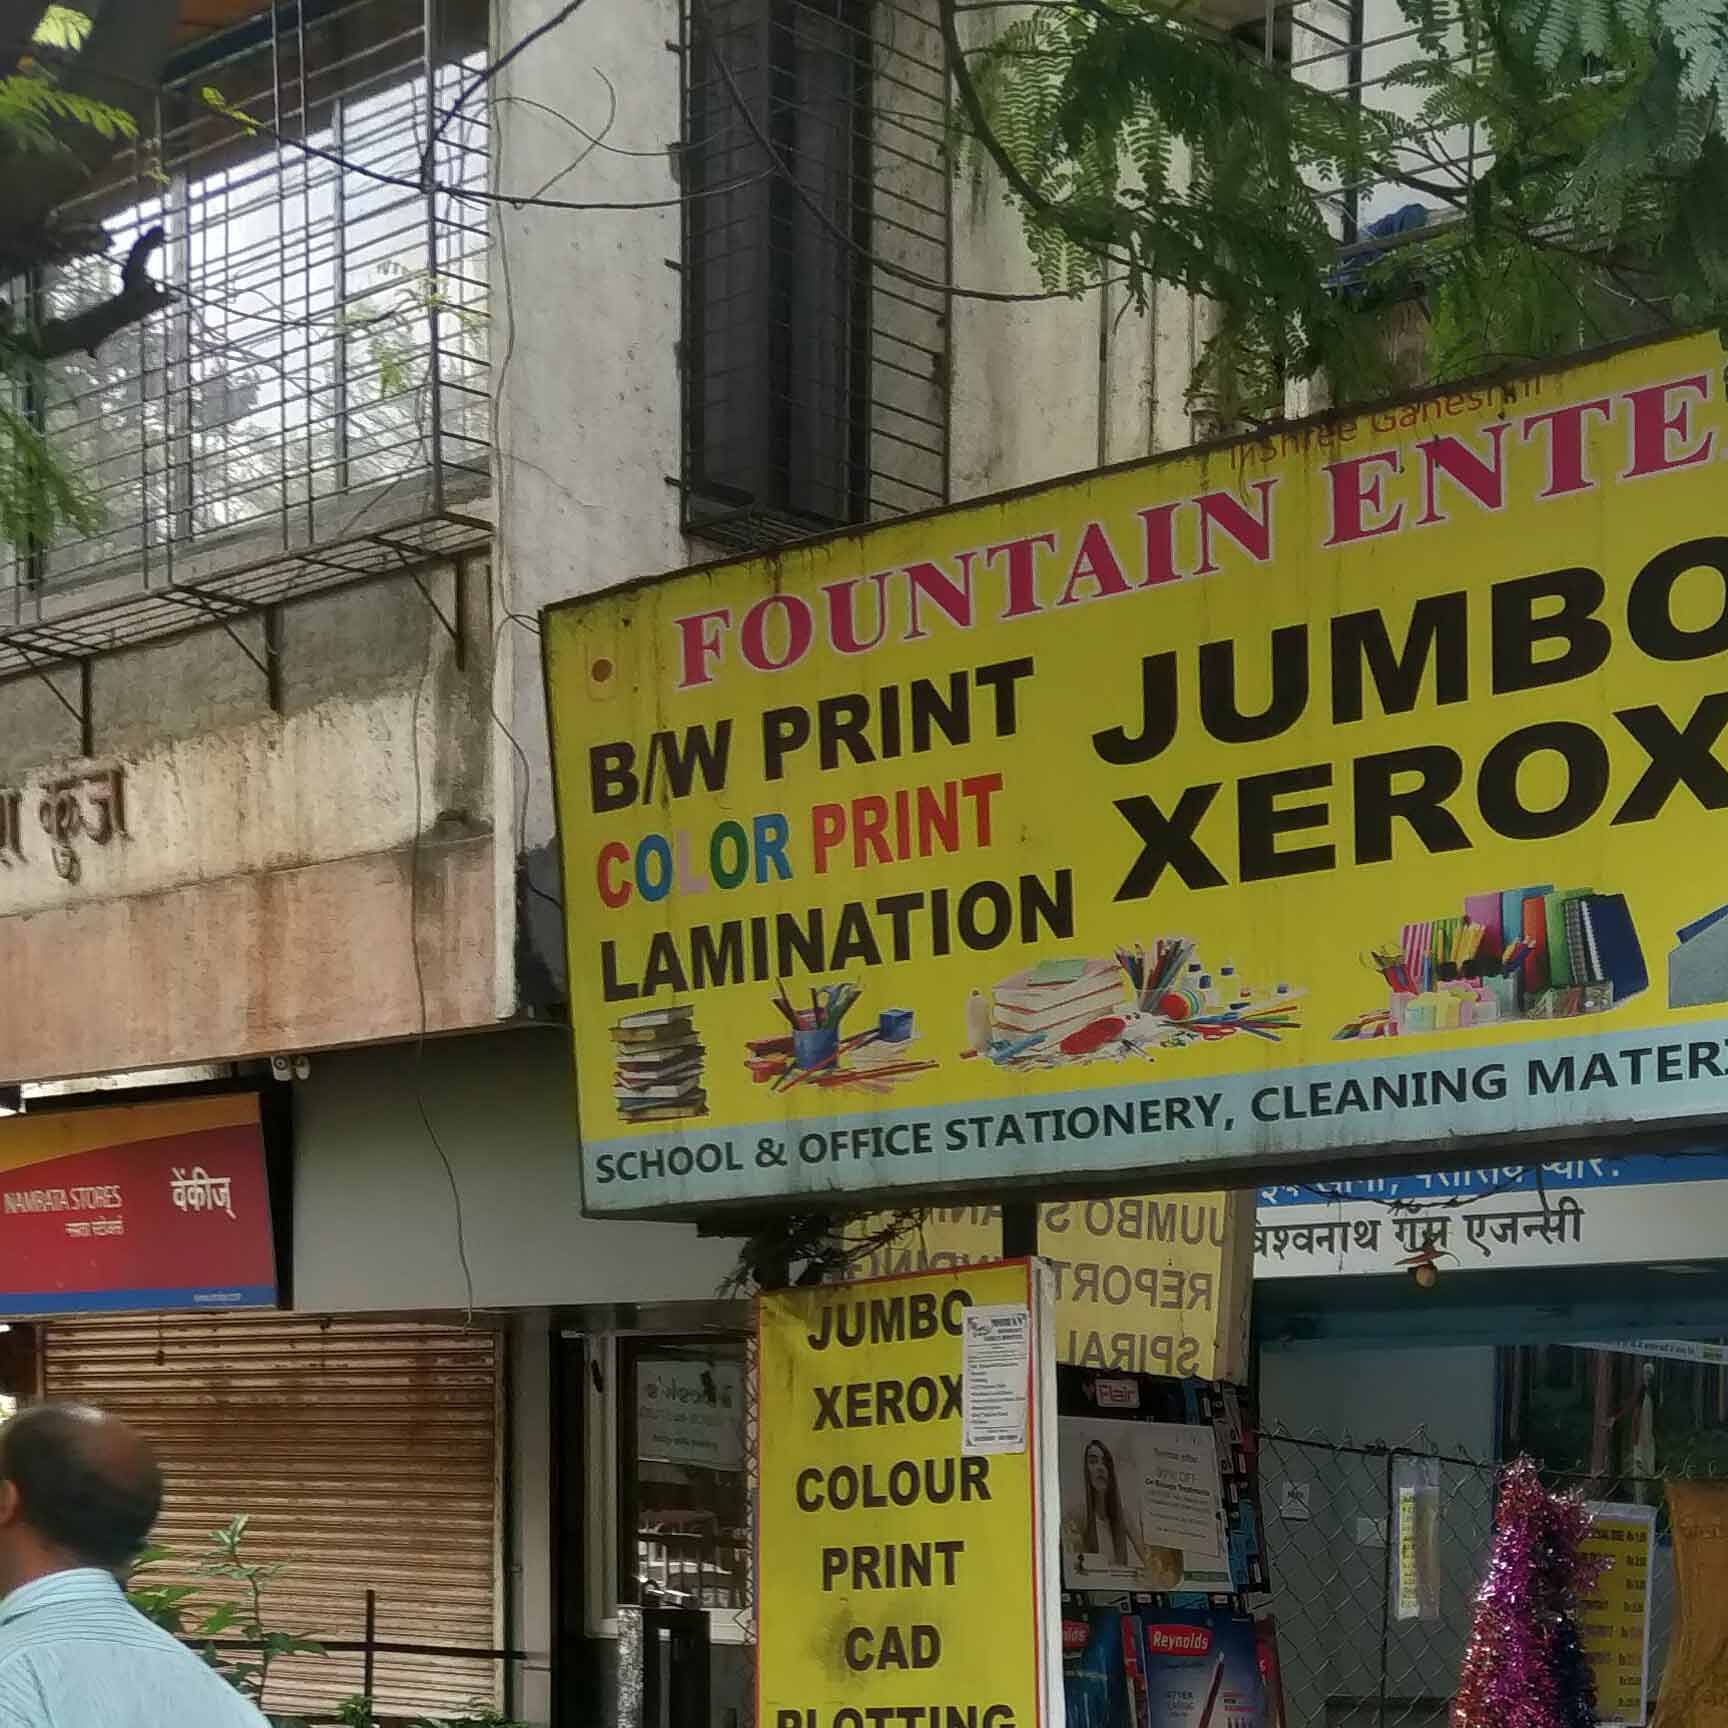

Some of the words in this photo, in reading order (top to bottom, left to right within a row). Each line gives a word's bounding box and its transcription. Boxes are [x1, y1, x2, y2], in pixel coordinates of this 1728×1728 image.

[675, 477, 1277, 690] FOUNTAIN
[590, 720, 733, 814] B/W
[762, 656, 1035, 781] PRINT
[595, 813, 793, 909] COLOR
[812, 773, 1004, 874] PRINT
[601, 868, 1075, 1002] LAMINATION
[595, 1141, 742, 1184] SCHOOL
[755, 1138, 787, 1167] &
[799, 1124, 933, 1164] OFFICE
[944, 1093, 1234, 1151] STATIONERY,
[1250, 1061, 1507, 1121] CLEANING
[1463, 1196, 1585, 1258] एजन्सी
[806, 1289, 974, 1352] JUMBO
[812, 1372, 965, 1433] XEROX
[795, 1455, 993, 1515] COLOUR
[821, 1540, 966, 1593] PRINT
[844, 1623, 942, 1671] CAD
[1152, 1630, 1209, 1651] Reynolds
